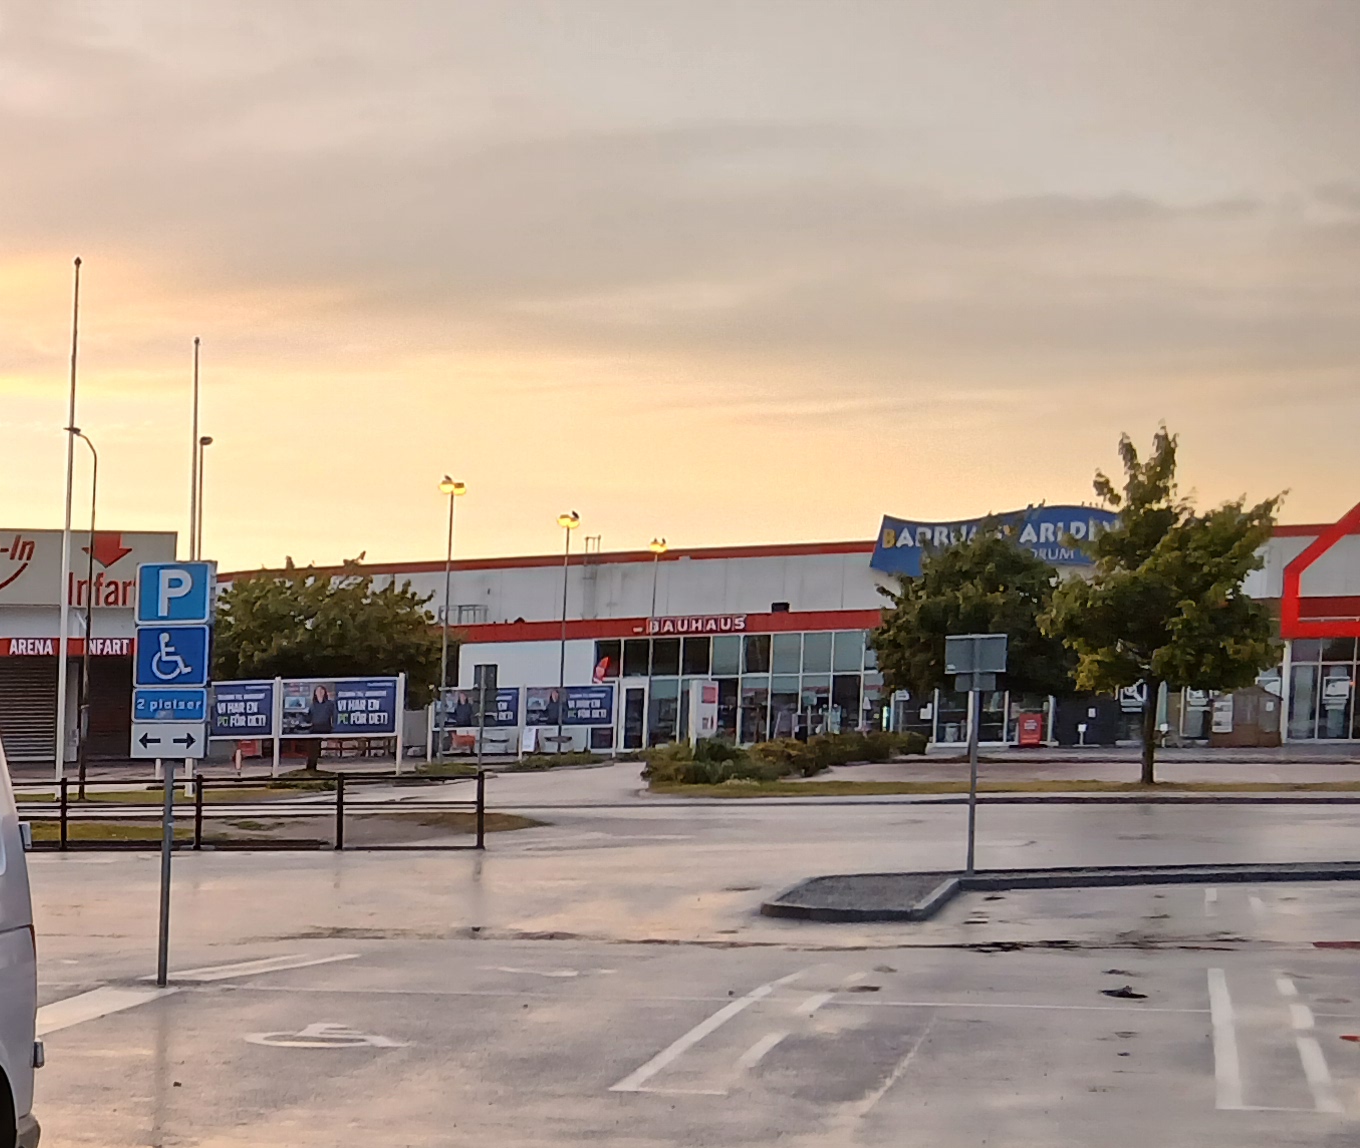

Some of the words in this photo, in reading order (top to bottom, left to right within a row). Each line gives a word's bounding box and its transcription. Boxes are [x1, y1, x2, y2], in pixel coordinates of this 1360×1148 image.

[68, 572, 137, 606] Infar
[157, 568, 193, 617] P
[648, 615, 747, 633] BAUHAUS
[9, 639, 54, 655] ARENA
[84, 638, 129, 656] NFART
[136, 698, 146, 710] 2
